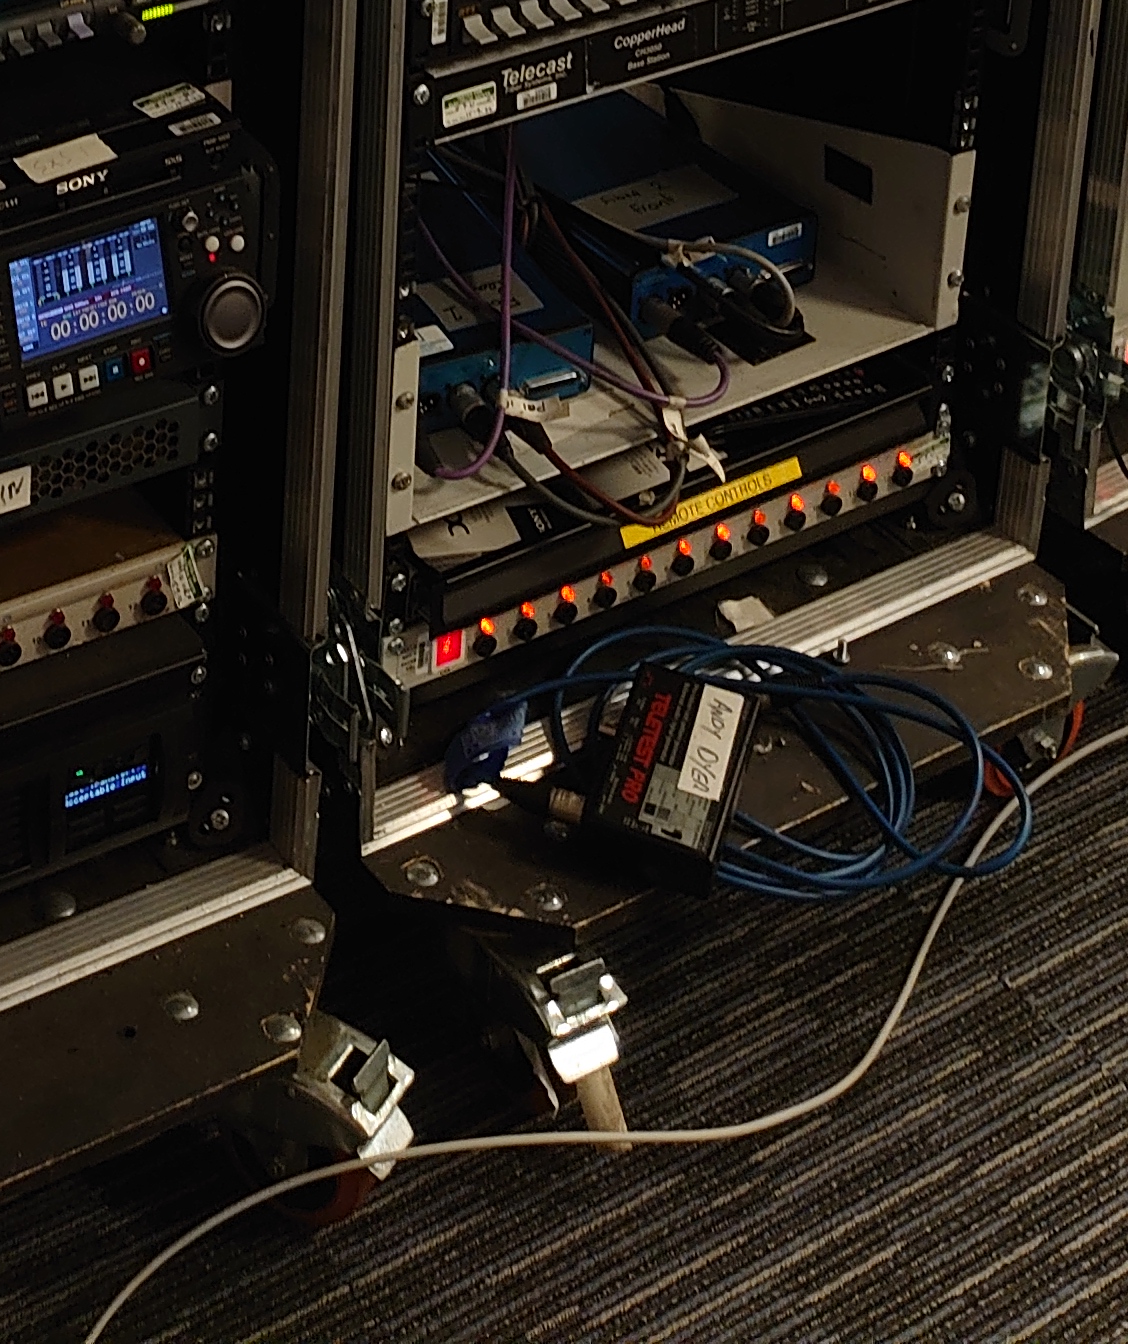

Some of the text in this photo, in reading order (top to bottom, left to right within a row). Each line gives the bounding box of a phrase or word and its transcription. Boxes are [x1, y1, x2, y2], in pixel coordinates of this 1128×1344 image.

[613, 16, 687, 51] CopperHead
[501, 50, 573, 89] Telecast
[55, 168, 110, 196] SONY
[50, 291, 156, 342] 00:00:00:00
[705, 472, 773, 509] CONTROLS
